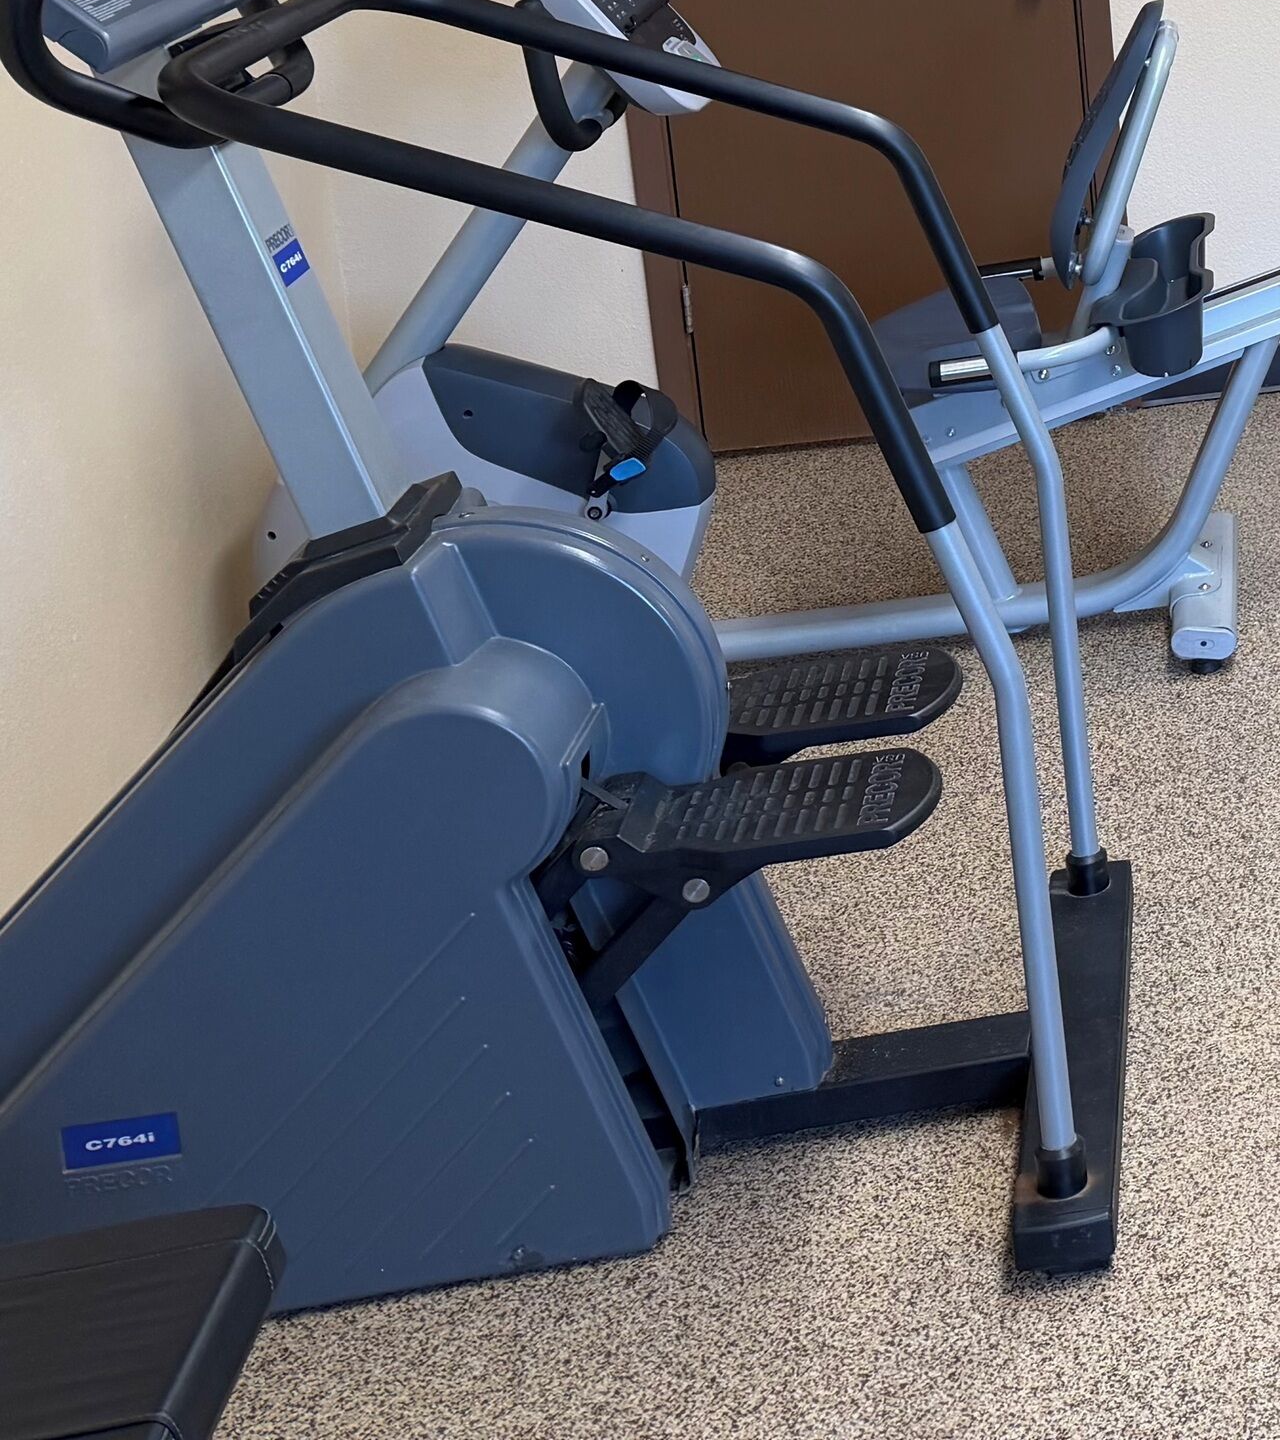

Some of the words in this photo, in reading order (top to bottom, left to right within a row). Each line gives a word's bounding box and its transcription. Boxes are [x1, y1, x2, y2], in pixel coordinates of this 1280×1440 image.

[265, 224, 294, 253] PRECOR
[280, 251, 303, 273] C764i
[885, 657, 928, 713] PRECOR
[857, 760, 904, 826] PRECOR
[85, 1132, 155, 1151] C764i
